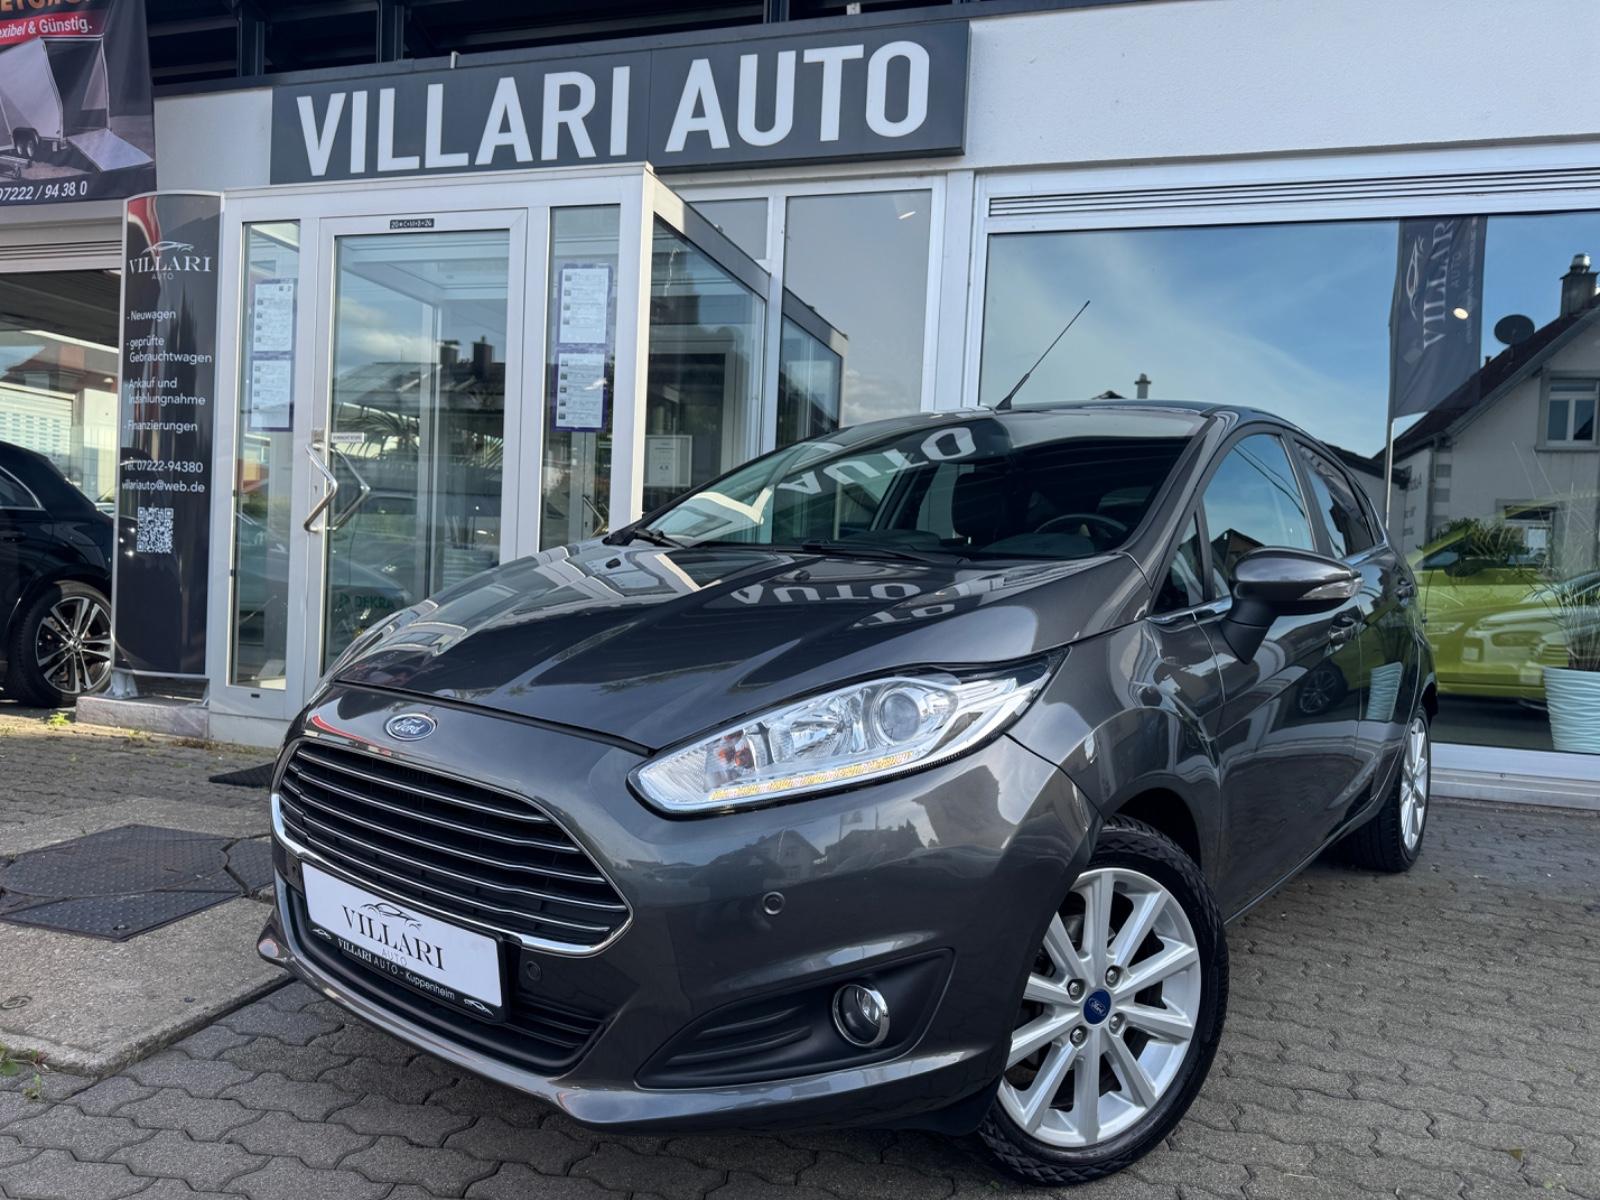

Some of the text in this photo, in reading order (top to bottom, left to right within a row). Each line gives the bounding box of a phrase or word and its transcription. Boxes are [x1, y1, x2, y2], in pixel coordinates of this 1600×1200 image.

[28, 21, 36, 34] &
[39, 16, 93, 33] Günstig.
[296, 40, 930, 177] VILLARI AUTO
[35, 185, 43, 200] /
[45, 184, 59, 198] 94
[61, 181, 76, 196] 38
[80, 181, 87, 195] 0
[129, 256, 212, 274] VILLARI
[151, 272, 175, 280] AUTO
[130, 310, 176, 322] Neuwagen
[129, 333, 165, 350] geprüfte
[129, 350, 212, 365] Gebrauchtwagen
[157, 377, 178, 388] und
[137, 459, 204, 473] 07222-94380
[342, 904, 447, 972] VILLARI
[381, 947, 408, 967] AUTO
[338, 938, 372, 963] VILLARI
[373, 955, 398, 975] AUTO
[405, 971, 455, 1000] Kuppenheim
